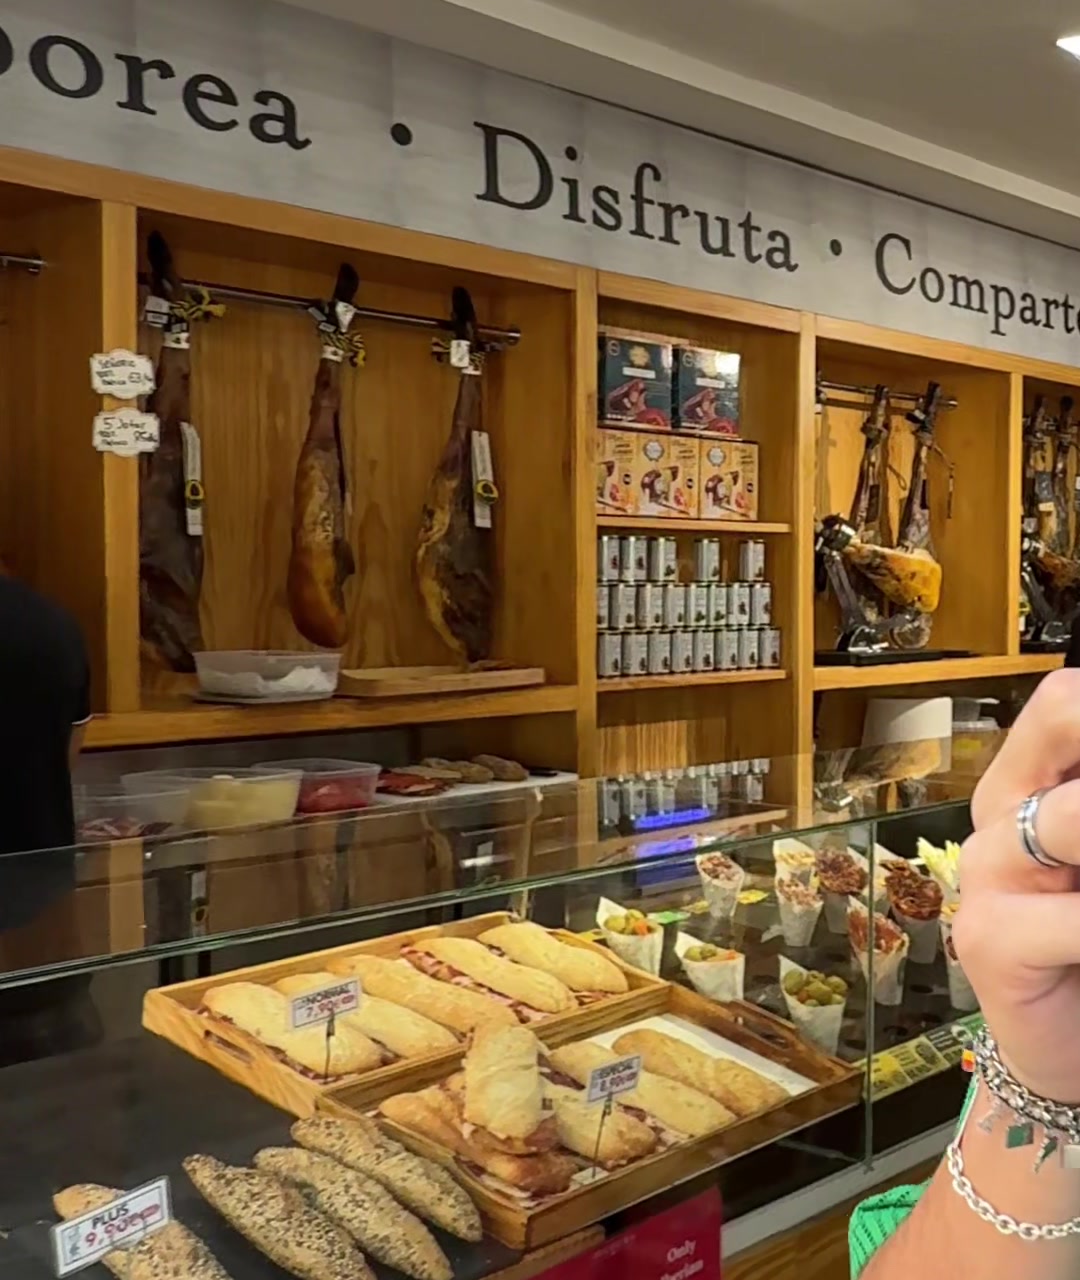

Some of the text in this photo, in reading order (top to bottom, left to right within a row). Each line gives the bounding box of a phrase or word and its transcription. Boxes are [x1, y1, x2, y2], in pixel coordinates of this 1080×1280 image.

[474, 121, 798, 273] Disfruta
[91, 1202, 129, 1230] PLUS
[667, 1239, 696, 1263] Only
